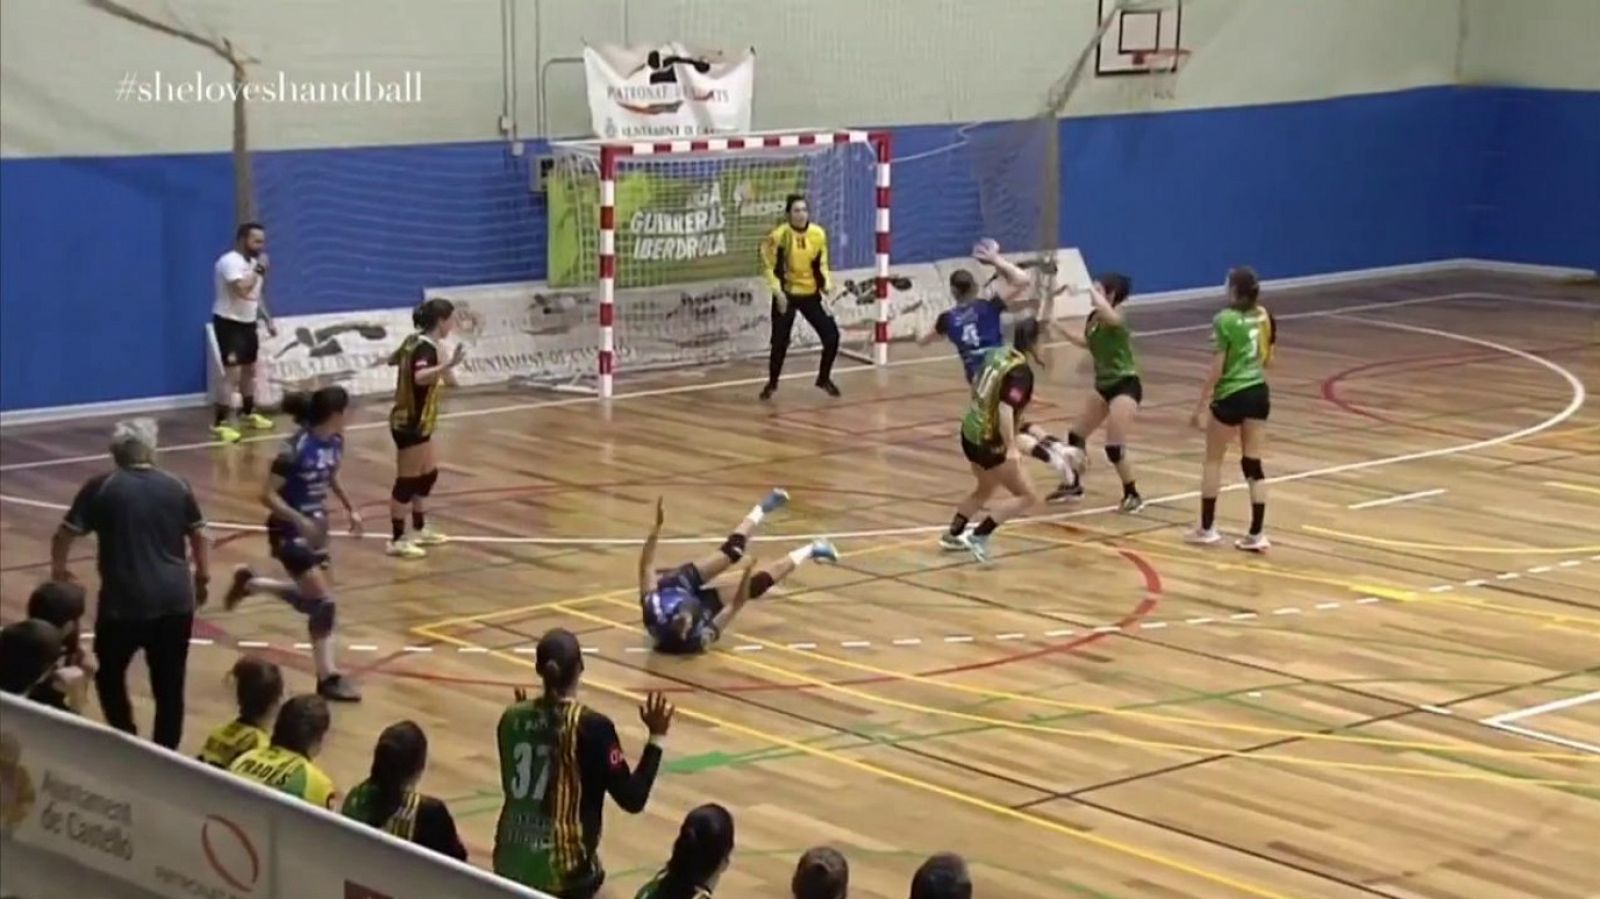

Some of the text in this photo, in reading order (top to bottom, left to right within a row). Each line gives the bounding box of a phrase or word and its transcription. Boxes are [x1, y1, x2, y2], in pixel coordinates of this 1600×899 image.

[630, 206, 727, 235] GUERRERAS
[633, 231, 728, 260] IBERDROLA
[511, 741, 551, 801] 37
[41, 801, 62, 835] de
